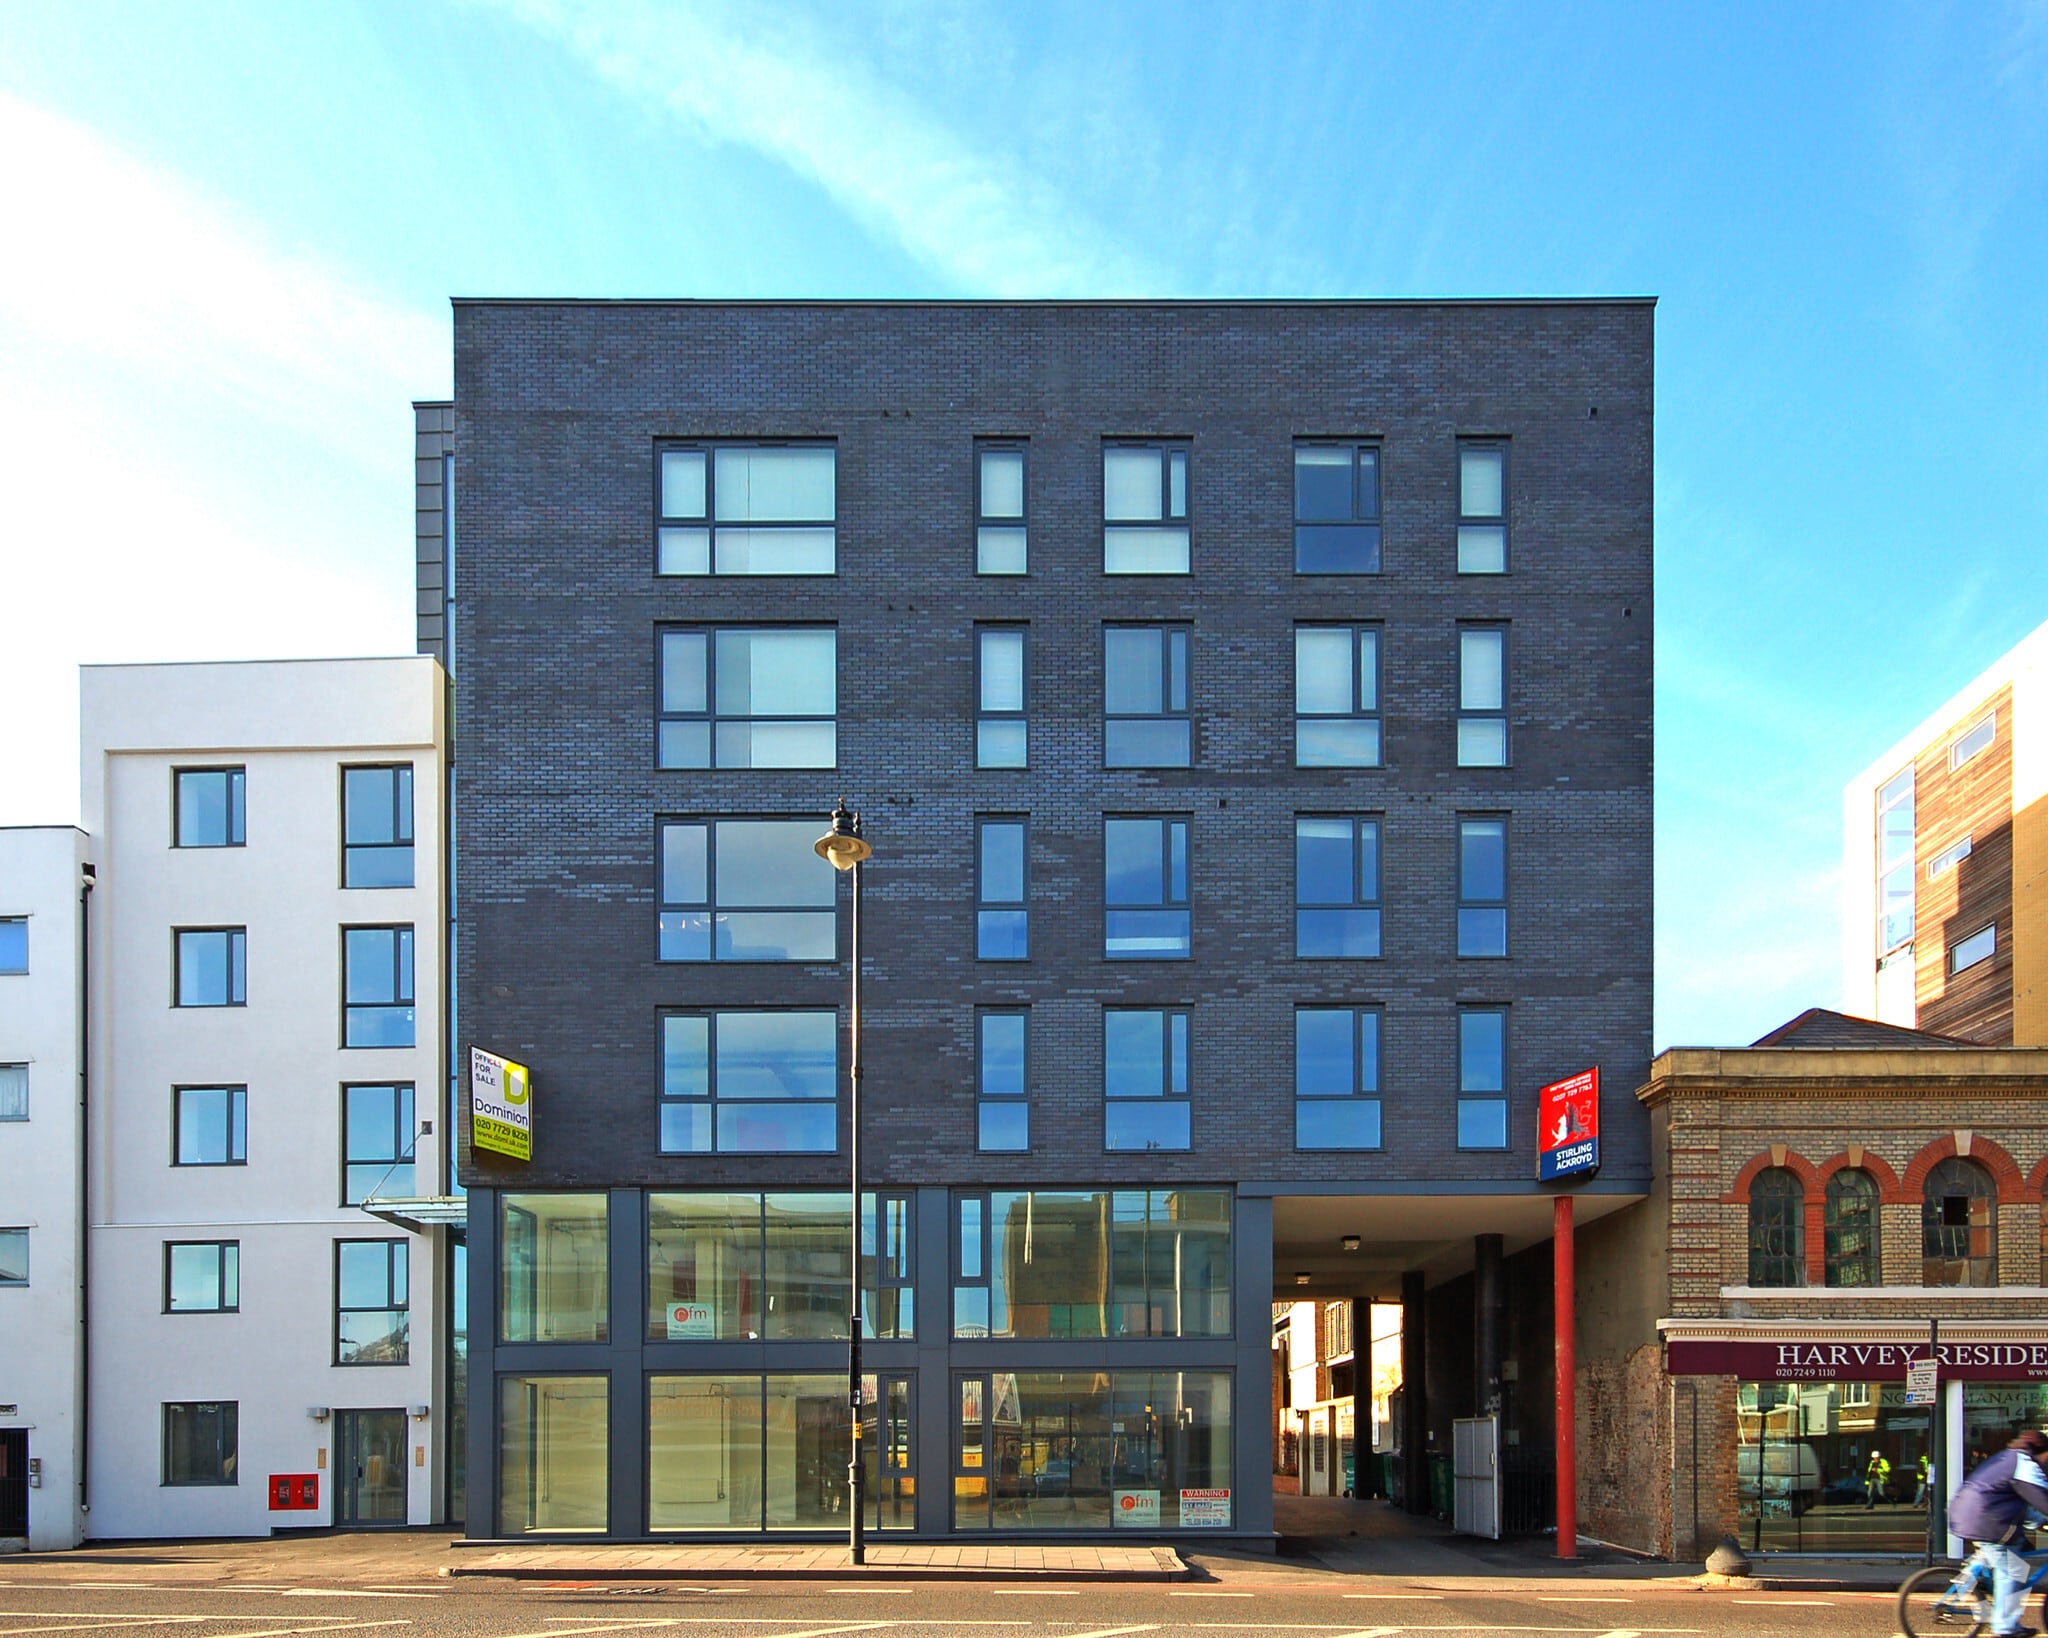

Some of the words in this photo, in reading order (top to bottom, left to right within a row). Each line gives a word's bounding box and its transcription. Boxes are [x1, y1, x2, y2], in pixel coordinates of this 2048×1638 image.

[475, 1062, 491, 1075] FOR
[475, 1072, 496, 1086] SALE
[475, 1098, 528, 1126] Dominion
[475, 1118, 491, 1130] 020
[1556, 1142, 1593, 1161] STIRLING
[1556, 1153, 1593, 1171] ACKROYD
[1776, 1345, 1920, 1366] HARVEY
[1936, 1345, 2048, 1366] RESIDE
[1776, 1368, 1792, 1377] 020
[1793, 1368, 1816, 1377] 7249
[1818, 1368, 1836, 1377] 1110
[1186, 1489, 1225, 1498] WARNING
